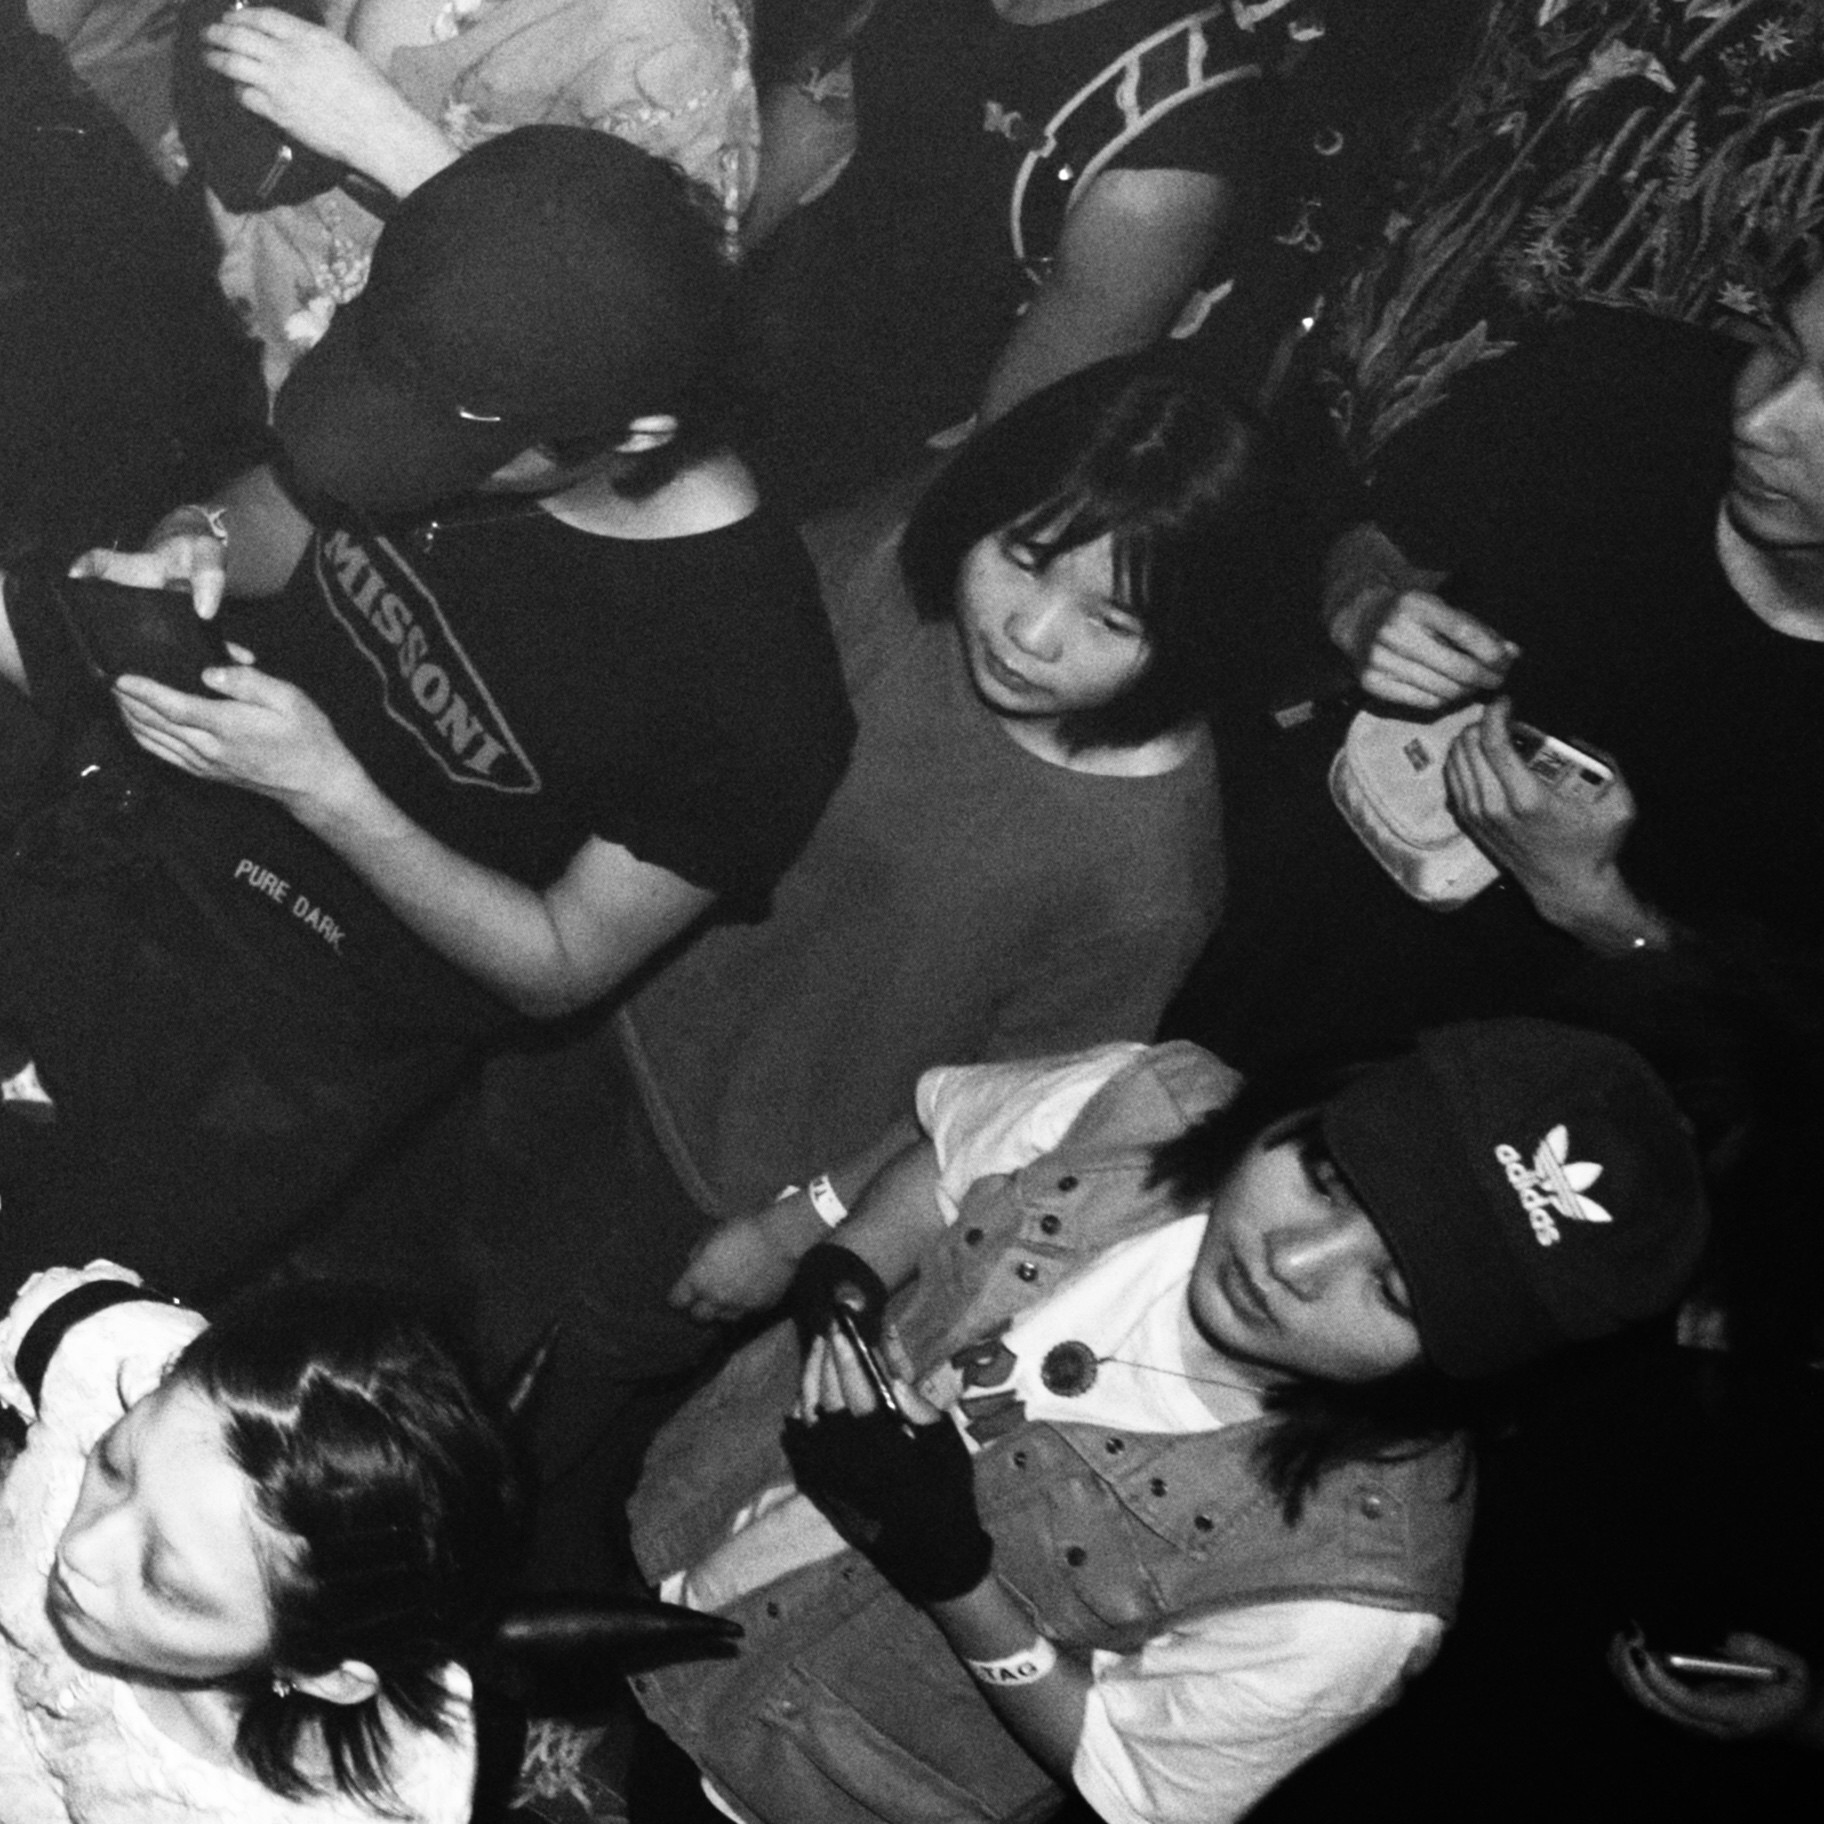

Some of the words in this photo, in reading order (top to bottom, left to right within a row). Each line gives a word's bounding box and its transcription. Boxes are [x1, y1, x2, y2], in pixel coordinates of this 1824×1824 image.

[322, 529, 509, 776] MISSONI
[233, 858, 292, 905] PURE
[291, 894, 346, 958] DARK
[1493, 1142, 1561, 1248] adidas
[980, 1662, 1037, 1682] TAG
